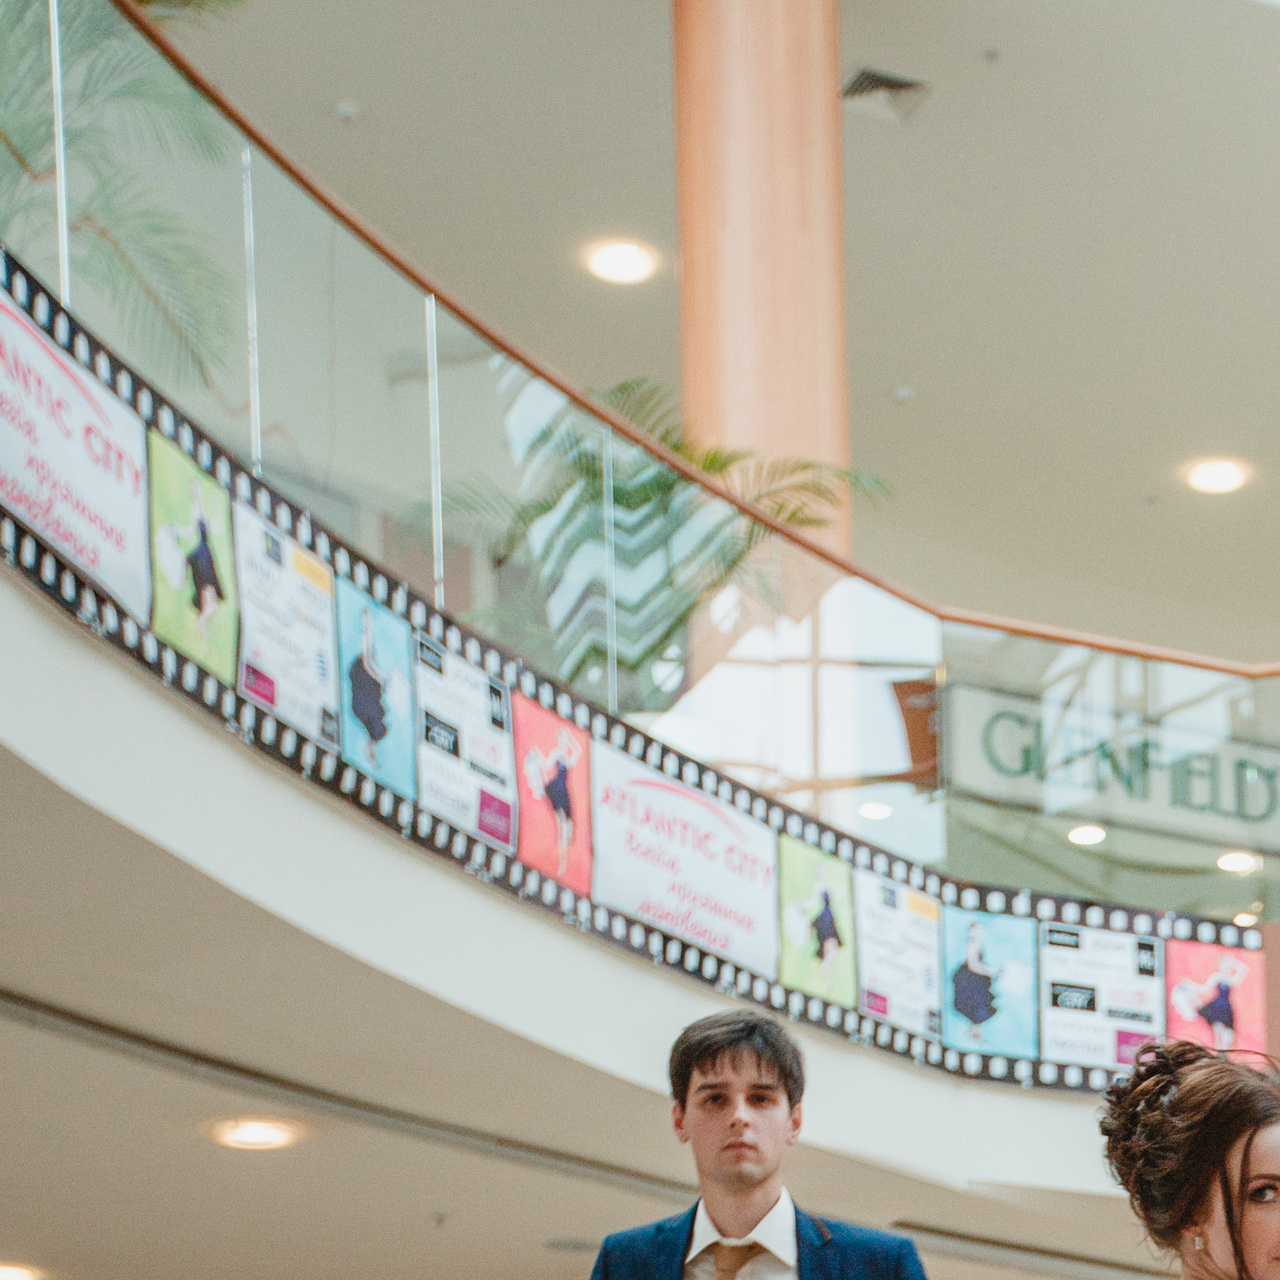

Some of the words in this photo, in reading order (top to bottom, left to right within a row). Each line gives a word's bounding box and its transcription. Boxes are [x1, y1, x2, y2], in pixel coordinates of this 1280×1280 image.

[84, 423, 142, 497] CITY
[979, 709, 1280, 824] GLNFIELD
[599, 785, 717, 860] ATLANTIC
[724, 843, 771, 887] CITY
